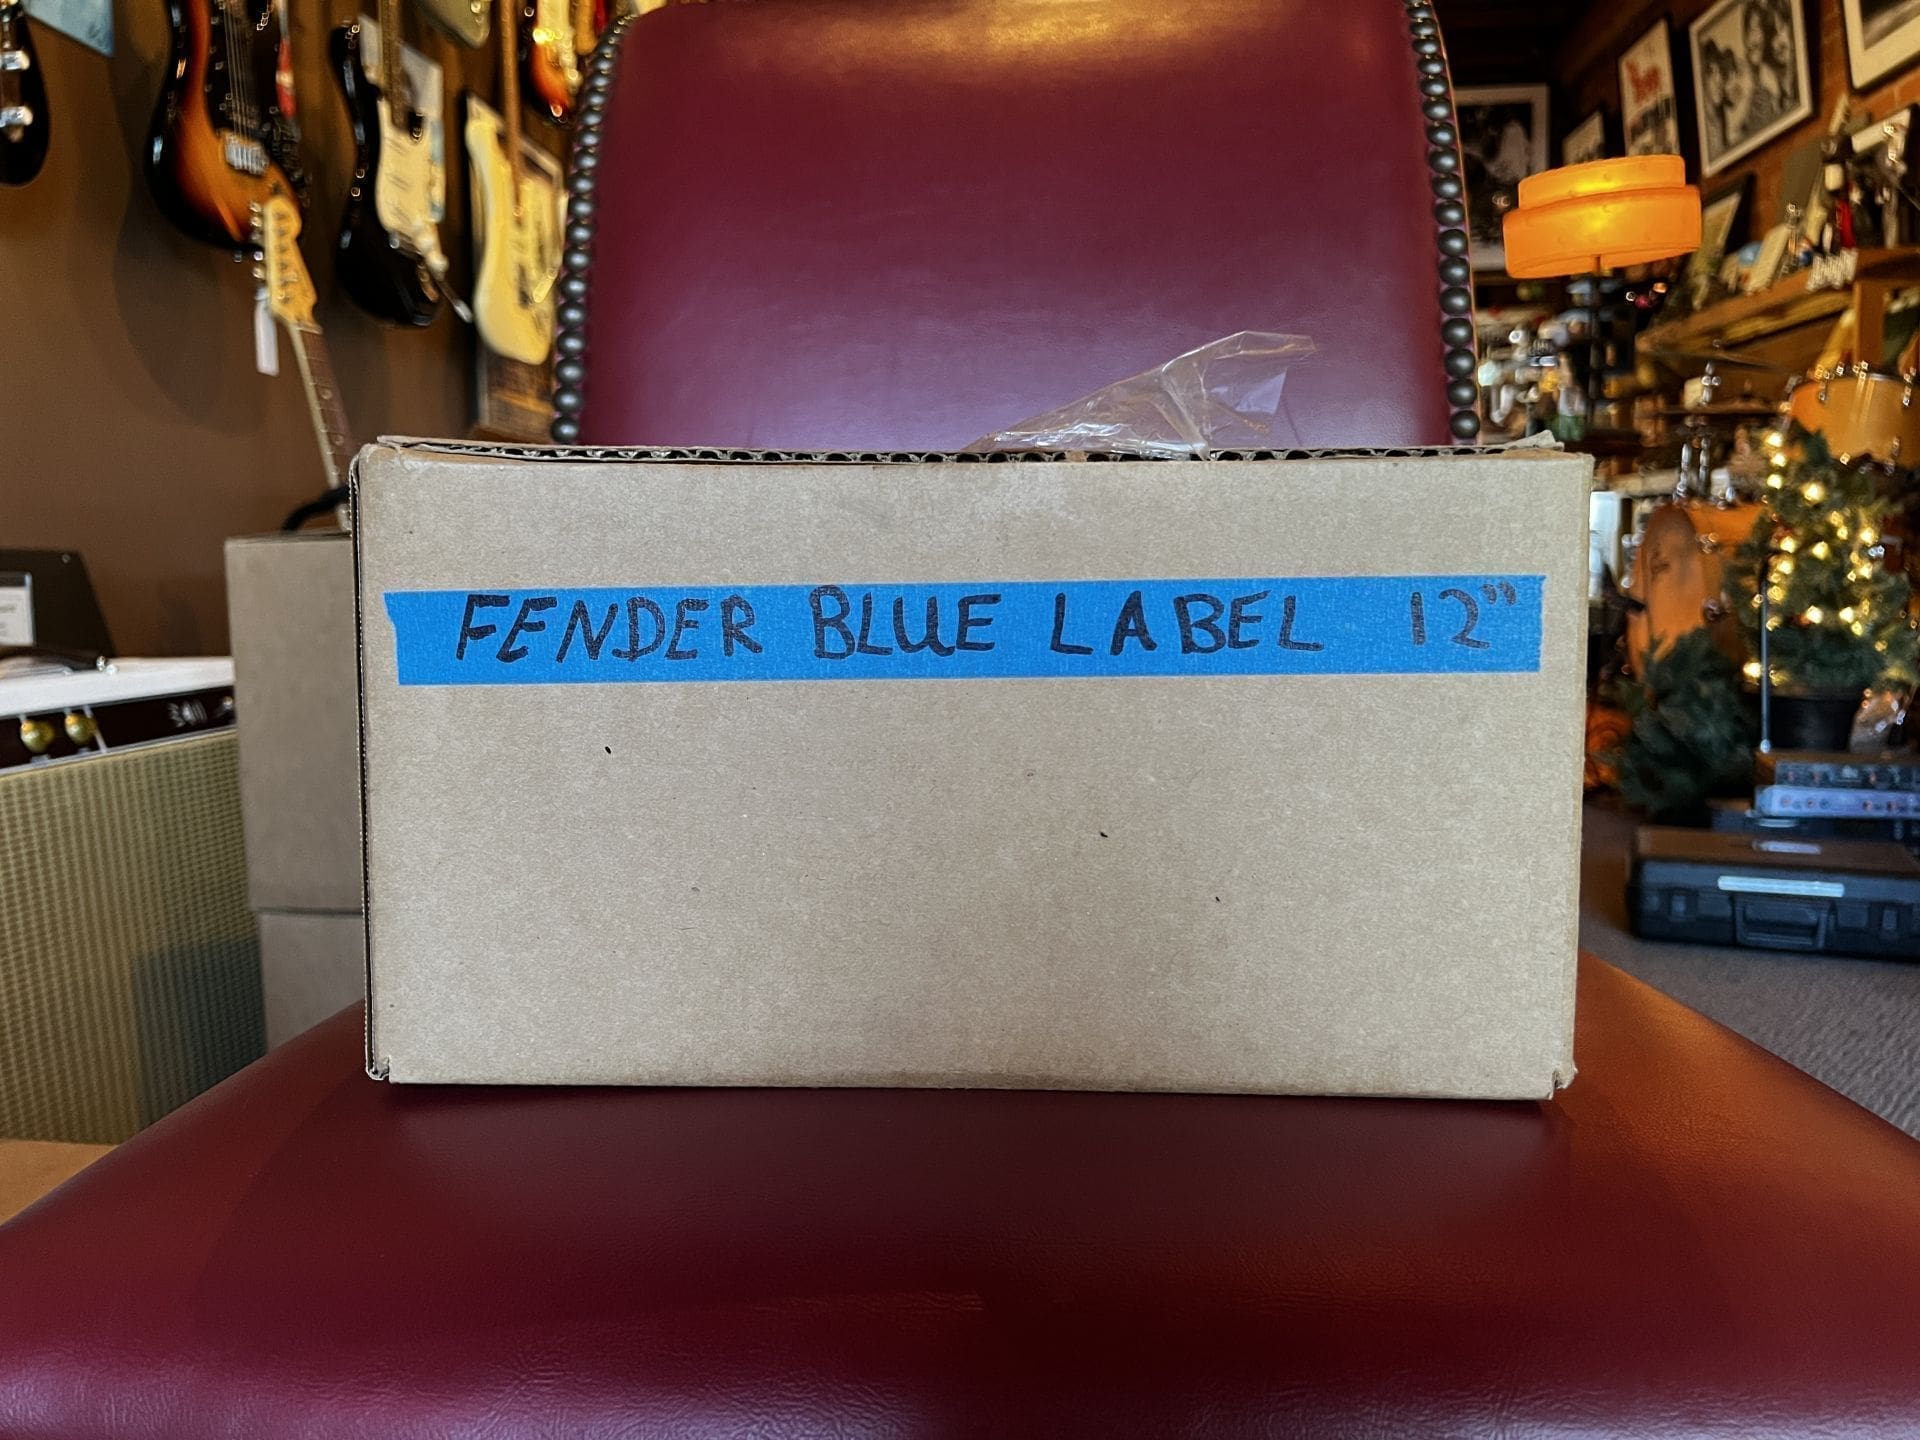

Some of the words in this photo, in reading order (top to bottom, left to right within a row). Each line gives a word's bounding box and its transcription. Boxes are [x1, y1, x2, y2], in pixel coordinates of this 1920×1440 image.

[455, 592, 764, 663] FENDER
[809, 584, 1002, 660] BLUE
[1050, 590, 1323, 656] LABEL
